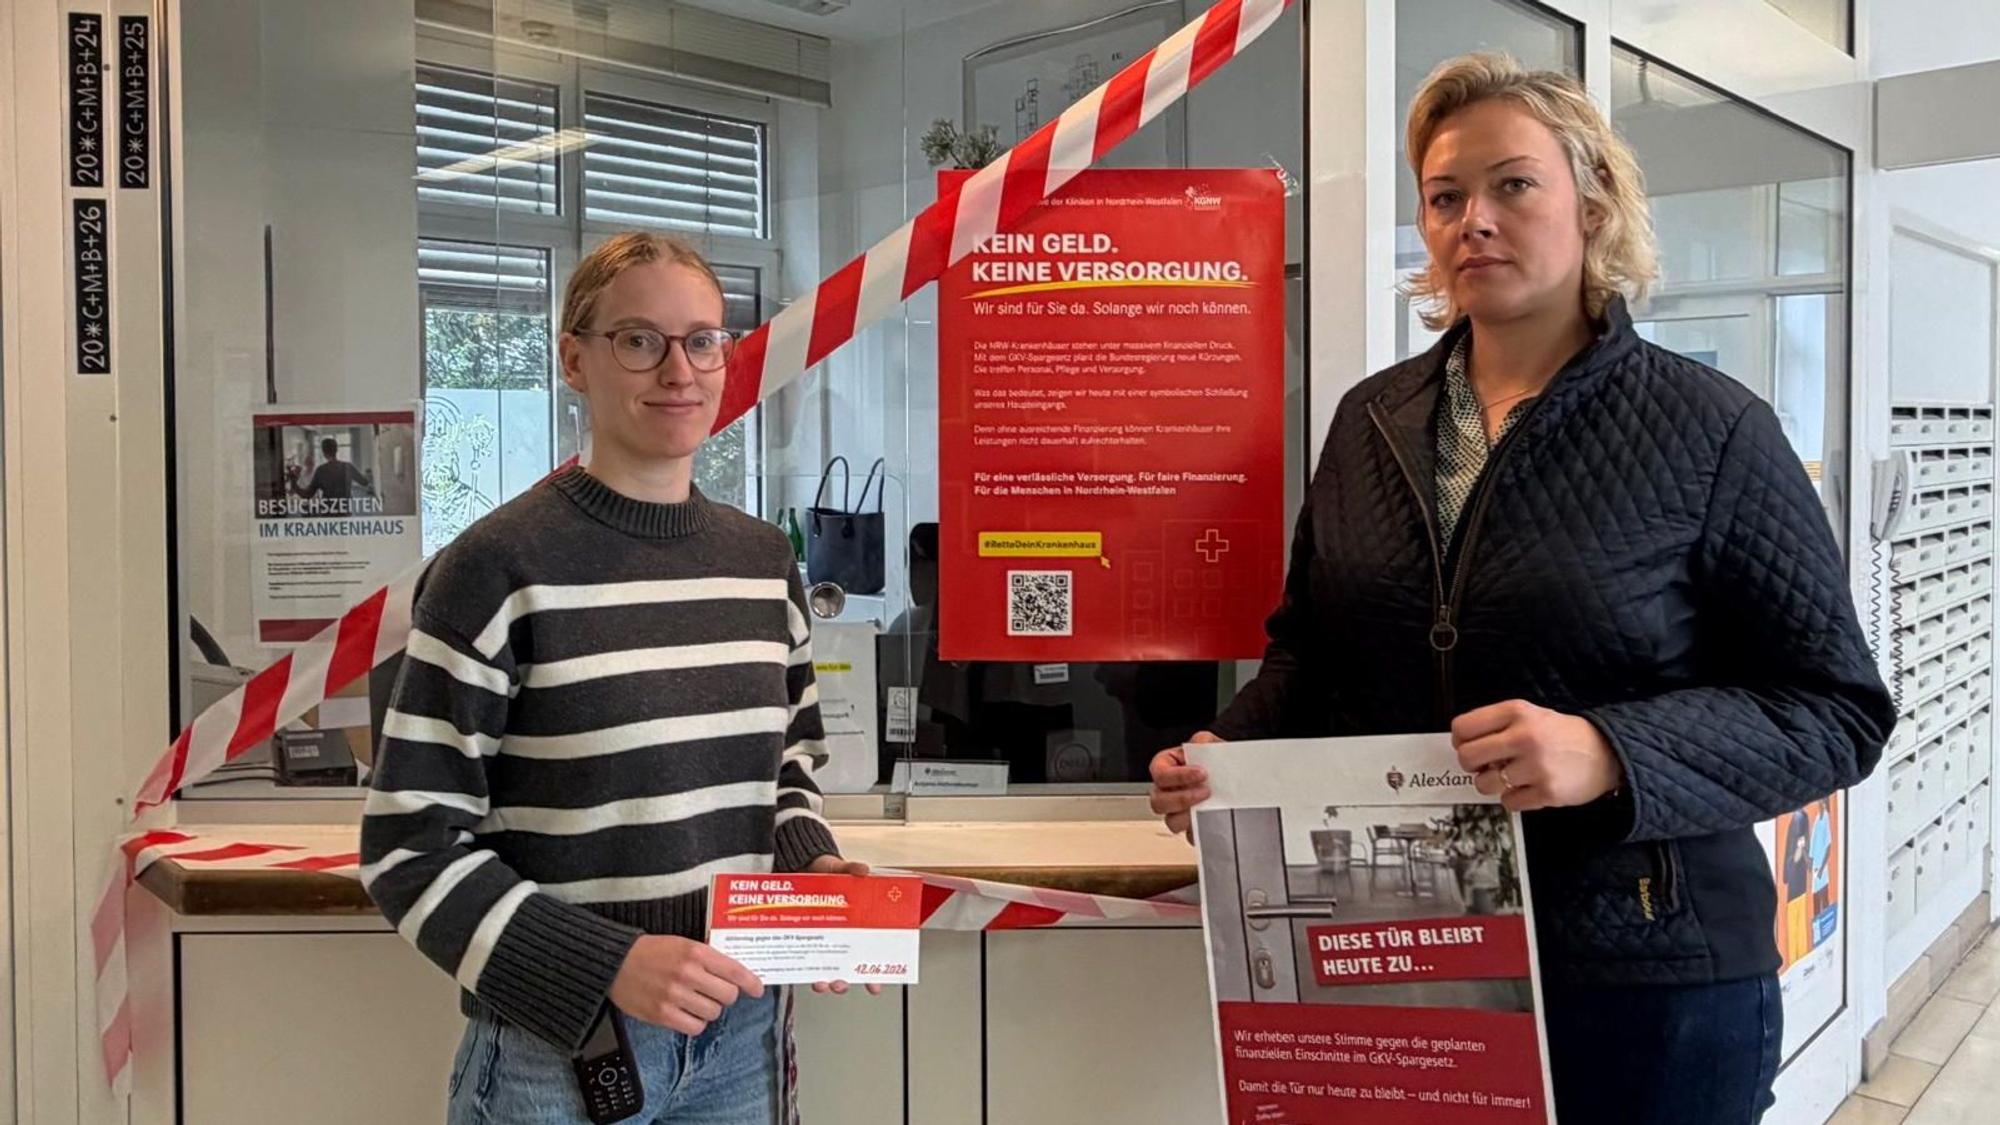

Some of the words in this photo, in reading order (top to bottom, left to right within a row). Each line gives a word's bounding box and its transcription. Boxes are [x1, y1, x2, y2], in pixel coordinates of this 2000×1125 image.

[973, 233, 1034, 253] KEIN
[1043, 232, 1118, 253] GELD.
[973, 262, 1051, 281] KEINE
[1057, 261, 1248, 281] VERSORGUNG.
[973, 302, 993, 314] Wir
[997, 302, 1022, 314] sind
[1026, 302, 1043, 314] für
[1047, 302, 1067, 314] Sie
[1070, 302, 1089, 314] da.
[1093, 302, 1142, 317] Solange
[1146, 302, 1165, 314] wir
[1168, 302, 1198, 314] noch
[1202, 302, 1251, 315] können.
[974, 341, 987, 349] Die
[1100, 342, 1120, 350] unter
[974, 353, 987, 361] Mit
[1056, 365, 1080, 375] Pflege
[1082, 365, 1097, 373] und
[974, 425, 996, 433] Denn
[973, 472, 991, 482] Für
[992, 473, 1014, 482] eine
[1016, 472, 1075, 482] verlässliche
[1077, 472, 1136, 483] Versorgung.
[1139, 472, 1155, 482] Für
[1157, 472, 1180, 482] faire
[1182, 472, 1248, 483] Finanzierung.
[973, 486, 991, 495] Für
[992, 486, 1008, 495] die
[1010, 486, 1061, 495] Menschen
[1063, 486, 1073, 495] in
[1075, 485, 1176, 496] Nordrhein-Westfalen
[258, 497, 383, 515] BESUCHSZEITEN
[259, 523, 279, 537] IM
[284, 520, 404, 536] KRANKENHAUS
[984, 540, 1096, 549] #RetteDeinKrankenhaus
[730, 880, 758, 890] KEIN
[761, 880, 794, 891] GELD.
[728, 894, 763, 904] KEINE
[766, 894, 848, 906] VERSORGUNG.
[1318, 933, 1373, 951] DIESE
[1378, 927, 1413, 948] TÜR
[1418, 926, 1484, 946] BLEIBT
[855, 964, 908, 974] 12.06.2026
[1323, 959, 1383, 976] HEUTE
[1387, 955, 1434, 973] ZU...
[1234, 1030, 1252, 1042] Wir
[1254, 1031, 1295, 1044] erheben
[1297, 1034, 1332, 1045] unsere
[1334, 1033, 1374, 1047] Stimme
[1376, 1037, 1409, 1050] gegen
[1411, 1036, 1428, 1048] die
[1431, 1037, 1486, 1052] geplanten
[1235, 1046, 1292, 1060] finanziellen
[1295, 1048, 1349, 1062] Einschnitte
[1353, 1051, 1366, 1063] im
[1369, 1051, 1457, 1069] GKV-Spargesetz.
[1238, 1079, 1269, 1093] Damit
[1271, 1080, 1287, 1093] die
[1289, 1081, 1305, 1095] Tür
[1307, 1086, 1324, 1096] nur
[1327, 1084, 1356, 1098] heute
[1360, 1090, 1372, 1099] zu
[1375, 1086, 1405, 1100] bleibt
[1418, 1090, 1440, 1102] und
[1443, 1091, 1469, 1104] nicht
[1472, 1092, 1488, 1105] für
[1491, 1095, 1531, 1109] immer!
